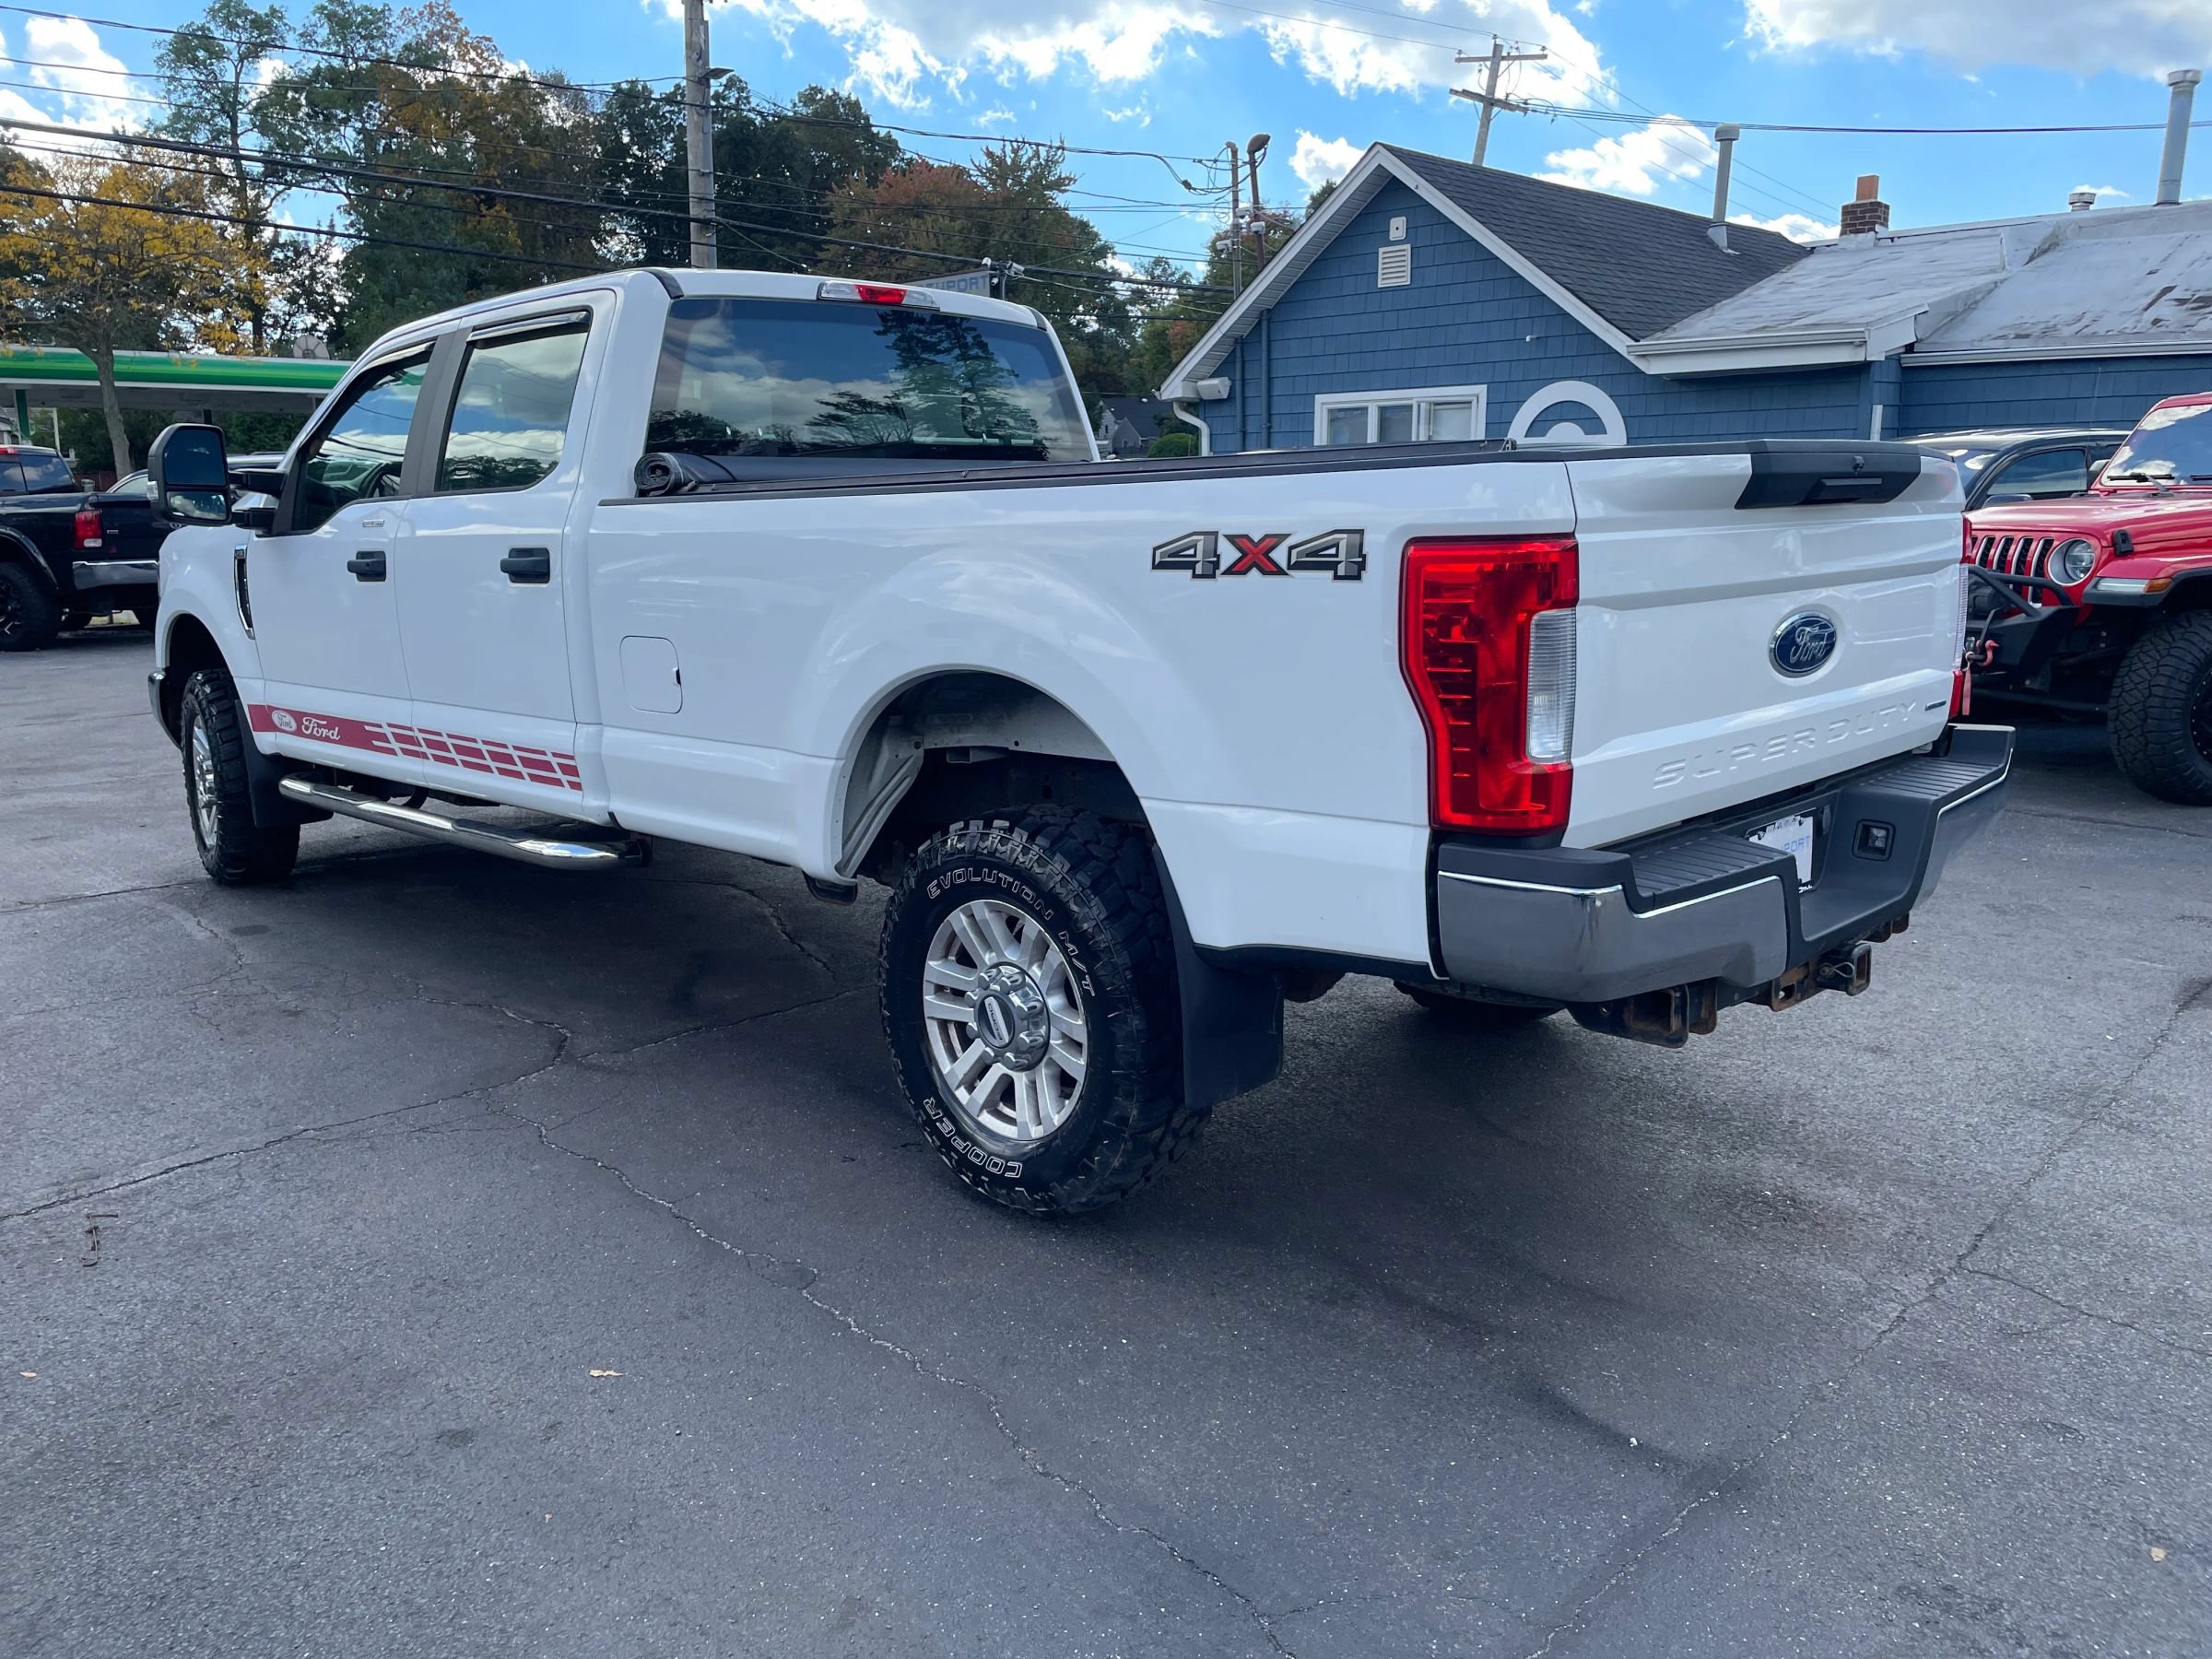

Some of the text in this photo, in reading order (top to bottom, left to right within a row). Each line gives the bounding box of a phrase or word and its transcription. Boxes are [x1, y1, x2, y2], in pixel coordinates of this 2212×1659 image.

[1790, 626, 1830, 664] Ford
[276, 712, 294, 730] Ford
[301, 716, 341, 740] Ford
[1653, 700, 1916, 789] SUPER DUTY
[926, 867, 1095, 996] EVOLUTION M/T
[923, 1097, 1023, 1178] COOPER
